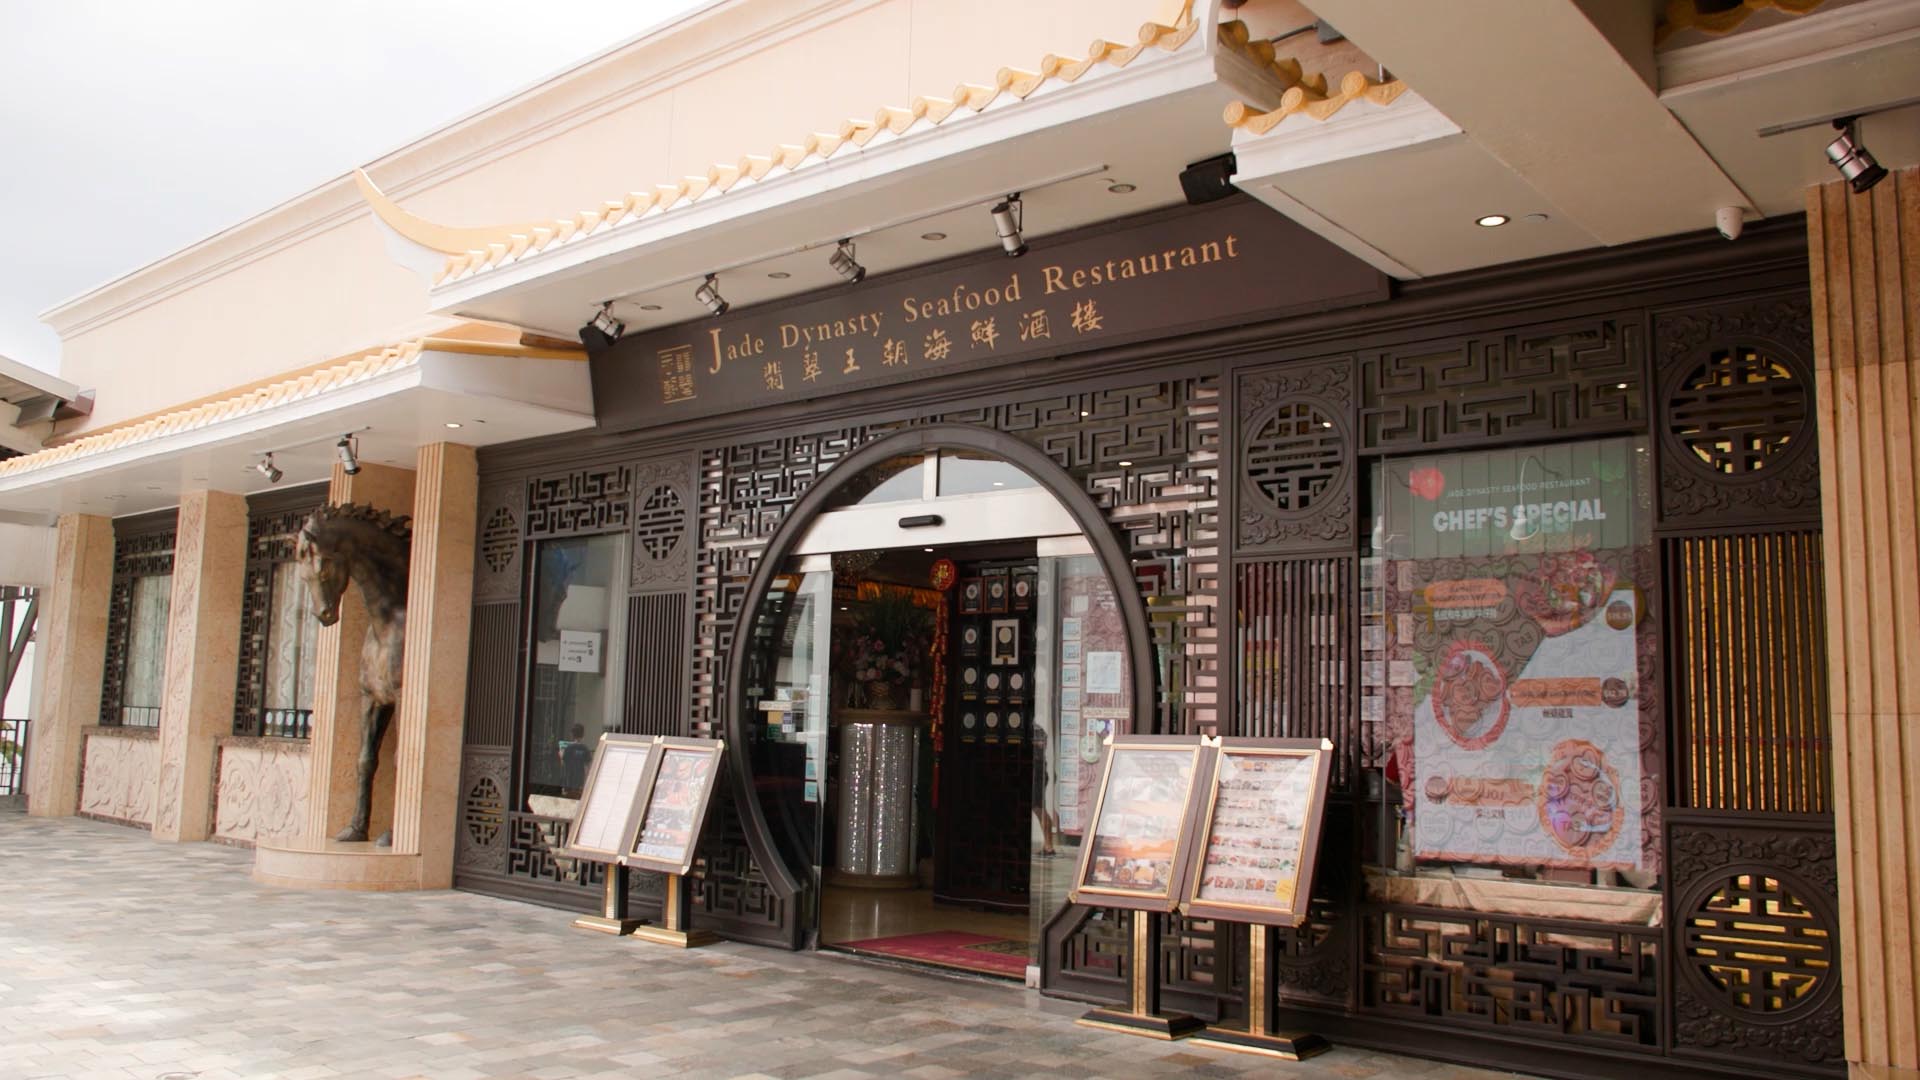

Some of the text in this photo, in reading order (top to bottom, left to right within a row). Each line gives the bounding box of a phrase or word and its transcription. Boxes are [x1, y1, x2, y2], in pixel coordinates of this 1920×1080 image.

[709, 327, 765, 374] Jade
[781, 309, 885, 353] Dynasty
[903, 273, 1021, 323] Seafood
[1043, 233, 1239, 294] Restaurant
[1432, 498, 1607, 532] CHEF'S SPECIAL
